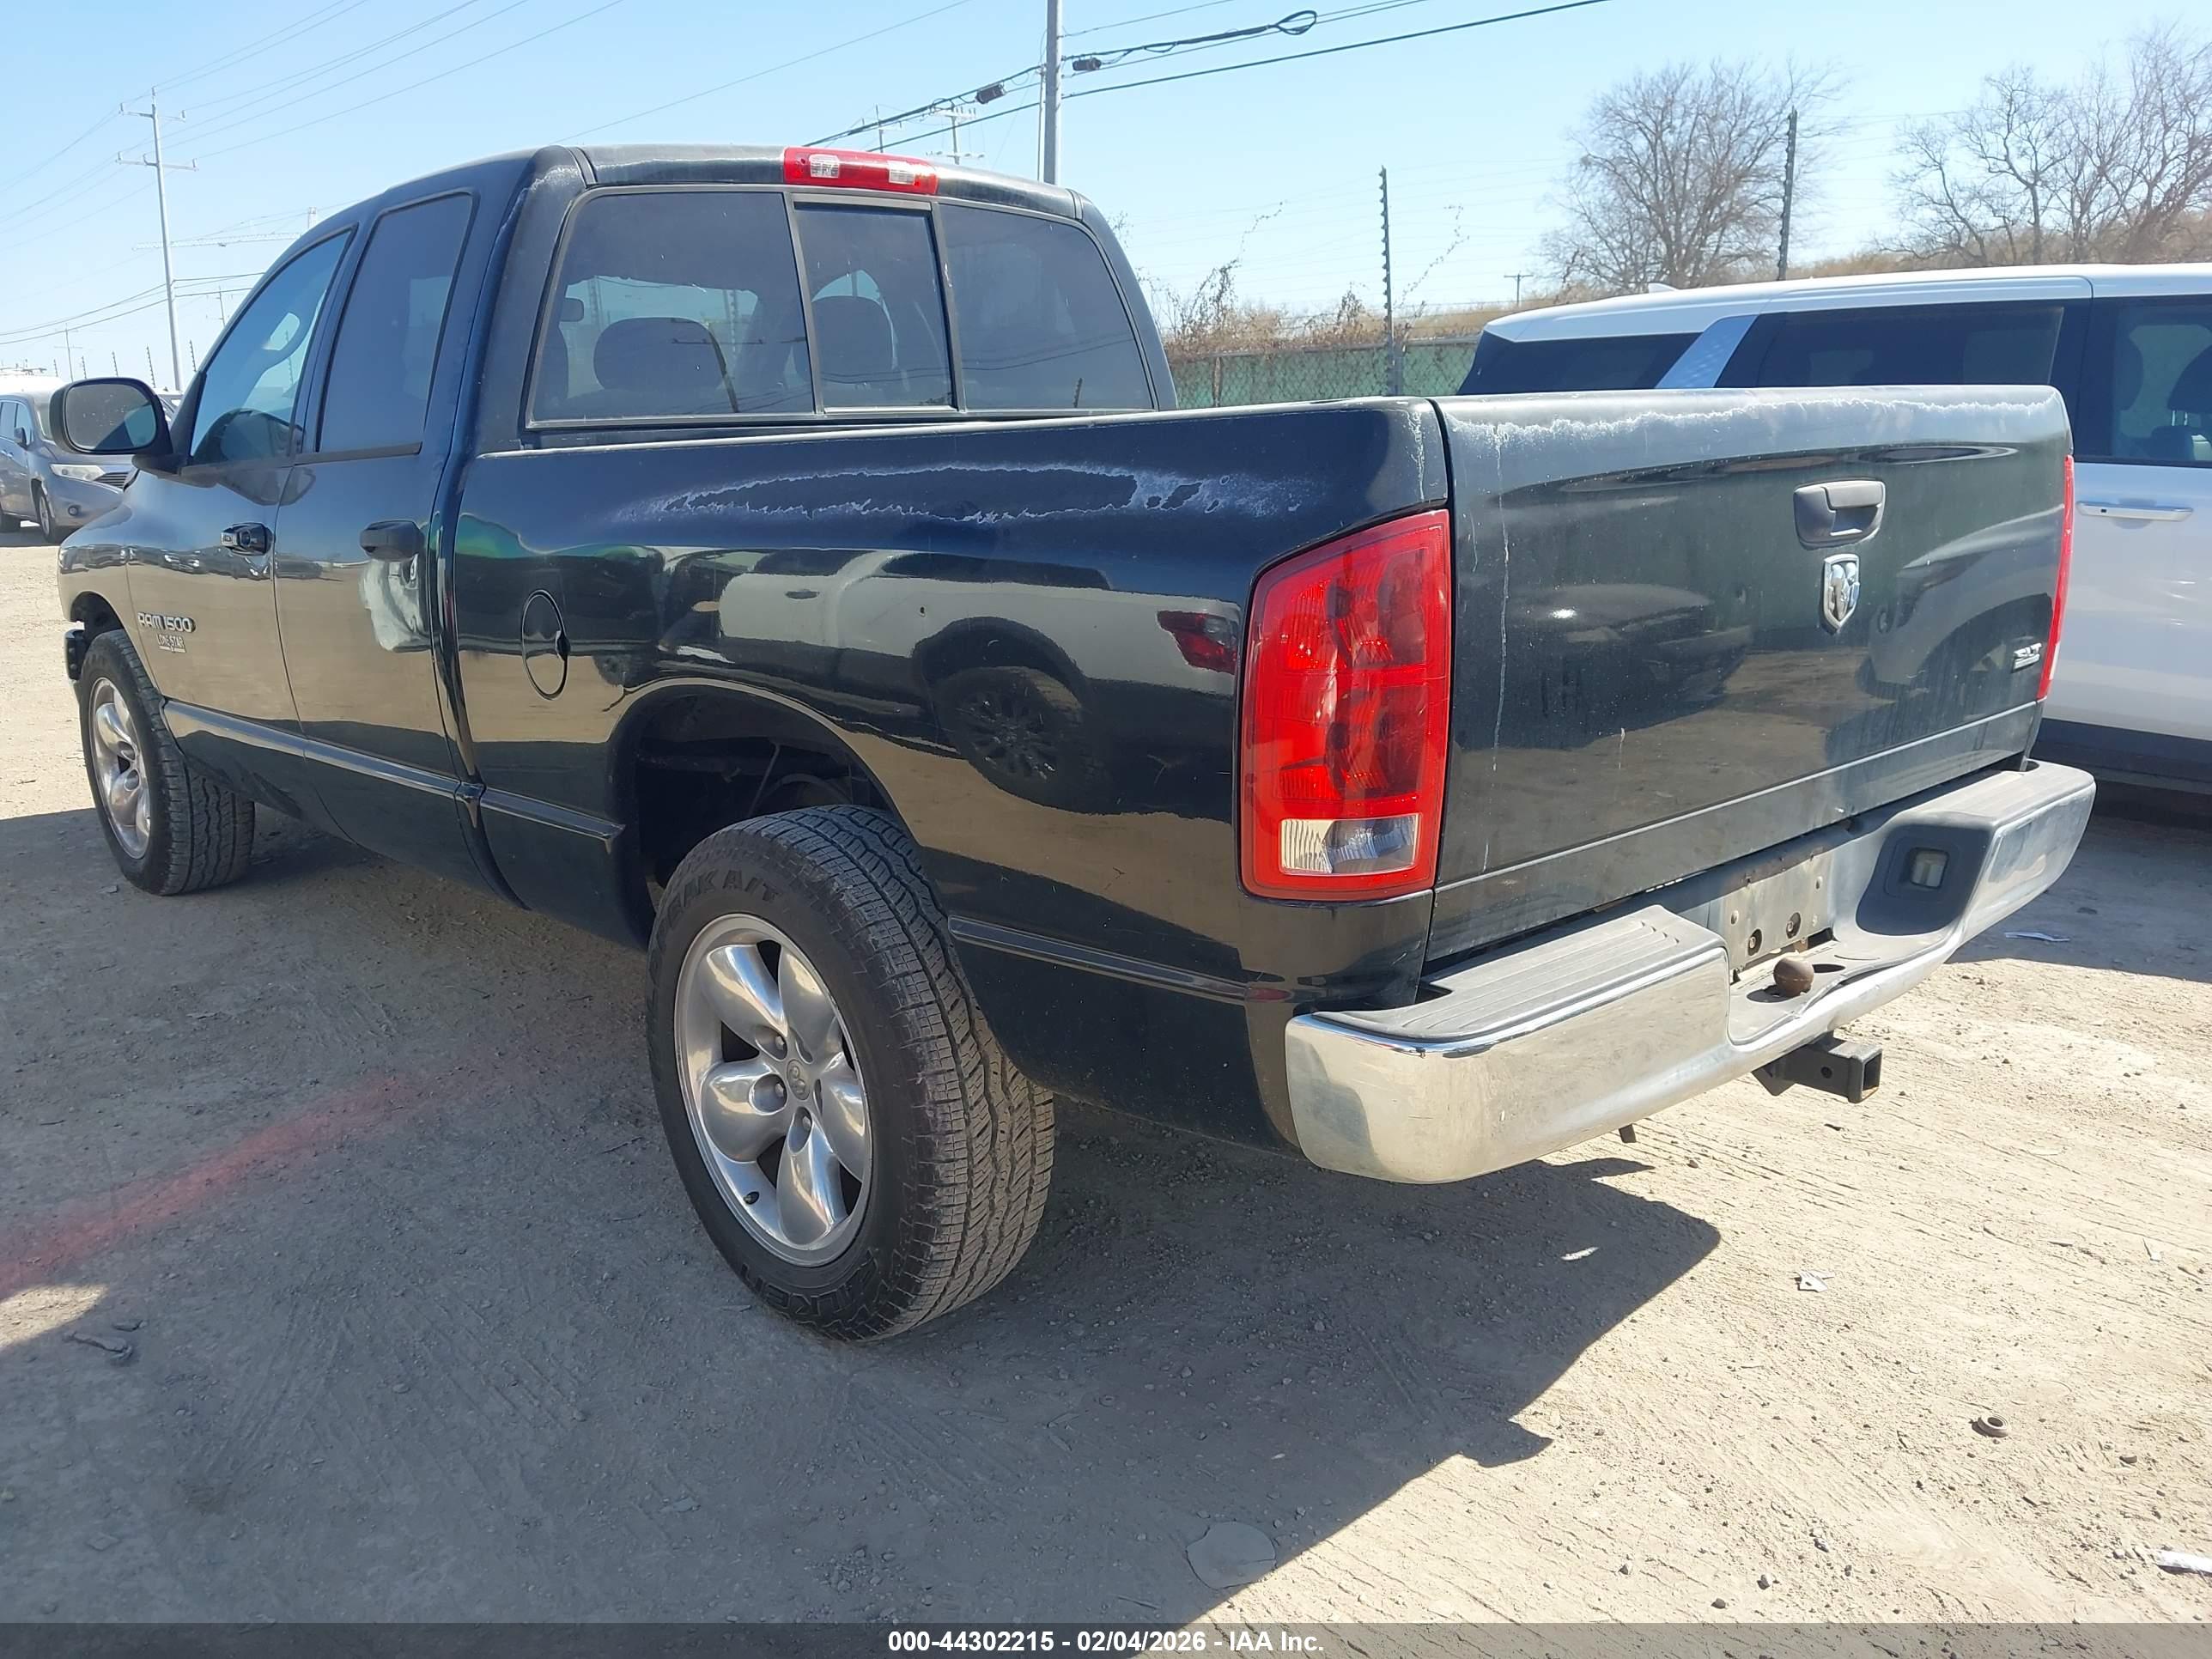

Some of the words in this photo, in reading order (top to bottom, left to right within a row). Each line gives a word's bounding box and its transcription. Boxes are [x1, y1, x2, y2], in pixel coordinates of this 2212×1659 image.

[137, 612, 164, 629] RAM
[163, 616, 196, 633] 1500
[156, 634, 170, 647] LONE
[168, 635, 185, 648] STAR
[2014, 642, 2042, 658] SLT
[722, 869, 779, 902] A/T
